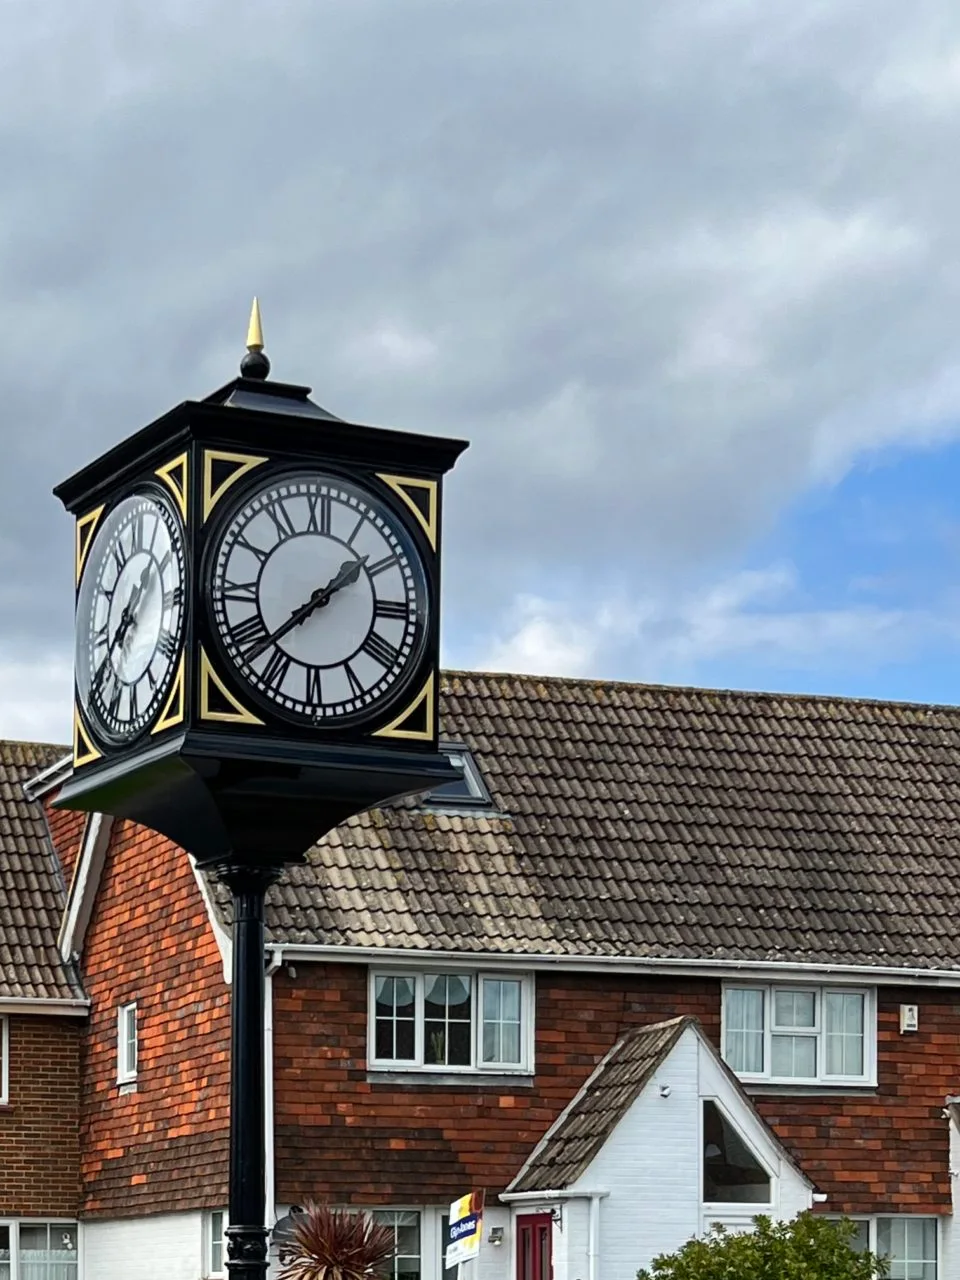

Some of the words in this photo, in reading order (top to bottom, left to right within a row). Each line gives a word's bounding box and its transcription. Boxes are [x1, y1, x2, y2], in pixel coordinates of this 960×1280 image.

[266, 500, 296, 541] XI
[306, 495, 331, 534] XII
[346, 513, 366, 548] I
[234, 533, 270, 564] X
[366, 554, 400, 577] II
[223, 579, 258, 603] IX
[375, 600, 409, 620] III
[361, 630, 401, 670] IIII
[260, 647, 292, 692] VII
[305, 666, 323, 704] VI
[343, 661, 366, 698] V
